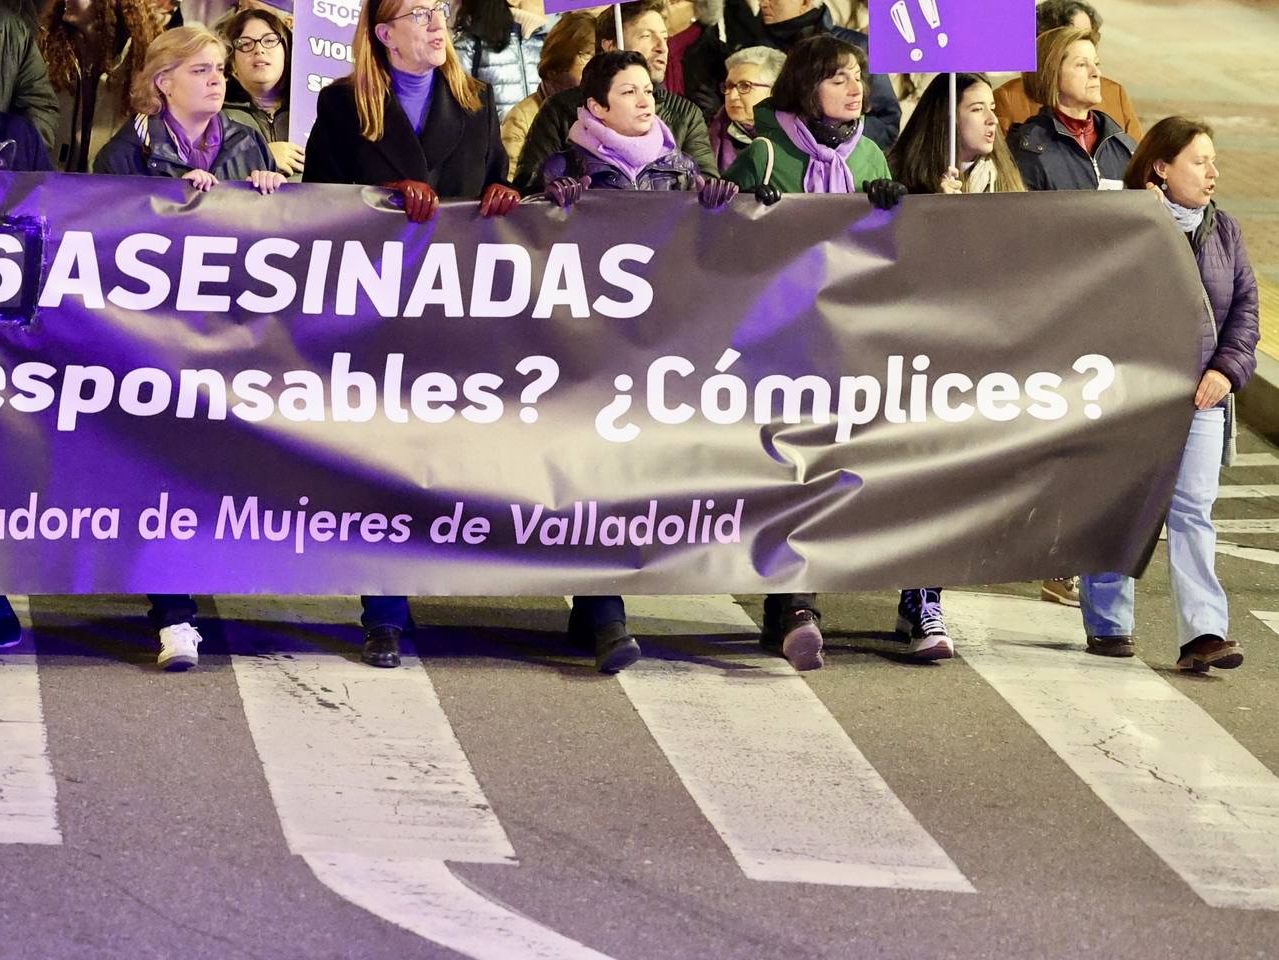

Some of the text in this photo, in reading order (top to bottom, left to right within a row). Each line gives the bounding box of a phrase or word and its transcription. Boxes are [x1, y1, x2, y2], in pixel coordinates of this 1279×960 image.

[316, 0, 360, 21] STOP
[38, 230, 656, 318] ASESINADAS
[594, 348, 1116, 442] ¿Cómplices?
[138, 492, 198, 541] de
[214, 495, 412, 554] Mujeres
[429, 501, 491, 545] de
[511, 498, 745, 546] Valladolid
